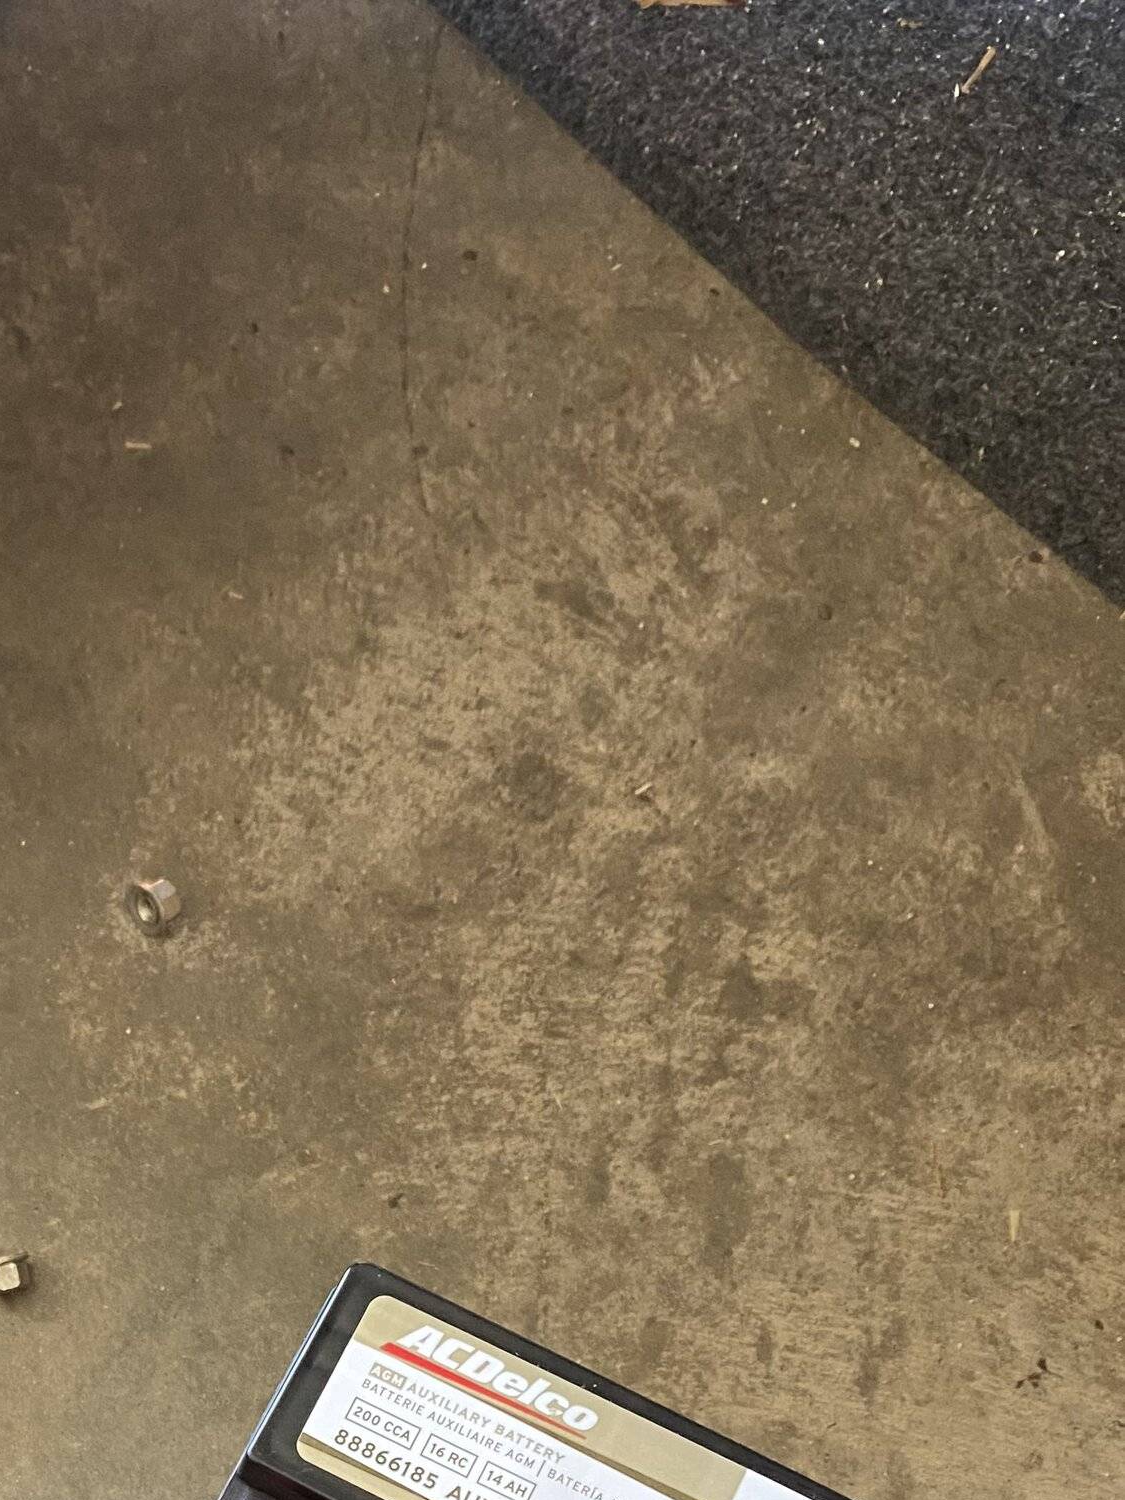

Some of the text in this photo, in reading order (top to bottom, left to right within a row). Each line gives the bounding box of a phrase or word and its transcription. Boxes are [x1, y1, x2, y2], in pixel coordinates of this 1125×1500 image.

[395, 1323, 598, 1430] ACDelco
[352, 1405, 413, 1442] 200 CCA
[361, 1377, 425, 1415] BATTERIE
[427, 1409, 502, 1453] AUXILIAIRE
[504, 1447, 535, 1469] AGM
[370, 1363, 565, 1465] AGM AUXILIARY BATTERY
[333, 1428, 439, 1490] 88866185
[429, 1442, 469, 1469] 16 RC
[485, 1470, 527, 1497] 14 AH
